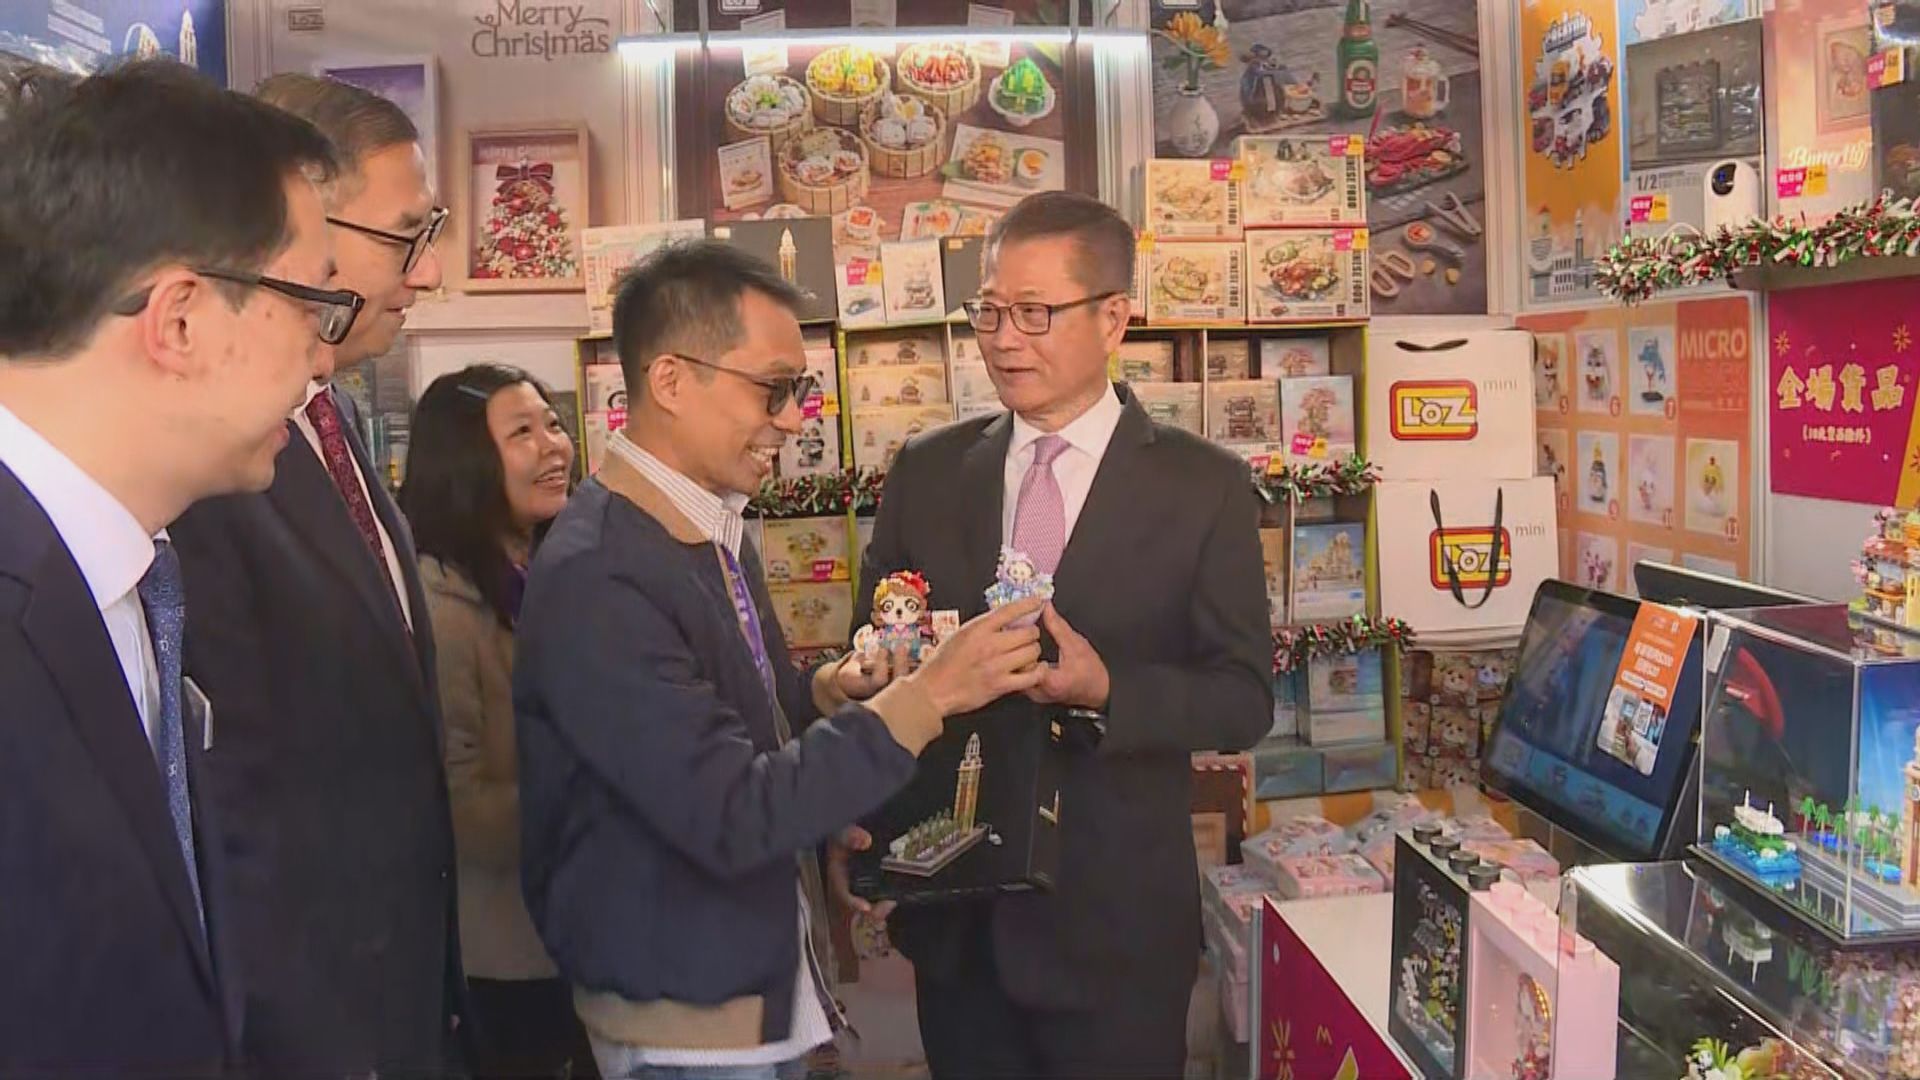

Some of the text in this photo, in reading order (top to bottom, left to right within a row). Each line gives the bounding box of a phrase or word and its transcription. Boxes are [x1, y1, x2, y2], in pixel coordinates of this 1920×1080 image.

[474, 0, 610, 33] Merry
[1637, 174, 1658, 191] 1/2
[1680, 328, 1747, 359] MICRO
[1482, 379, 1519, 391] mini
[1776, 362, 1905, 414] 全場貨品
[1400, 395, 1479, 427] LOZ
[1514, 523, 1546, 537] mini
[1440, 542, 1511, 575] LOZ
